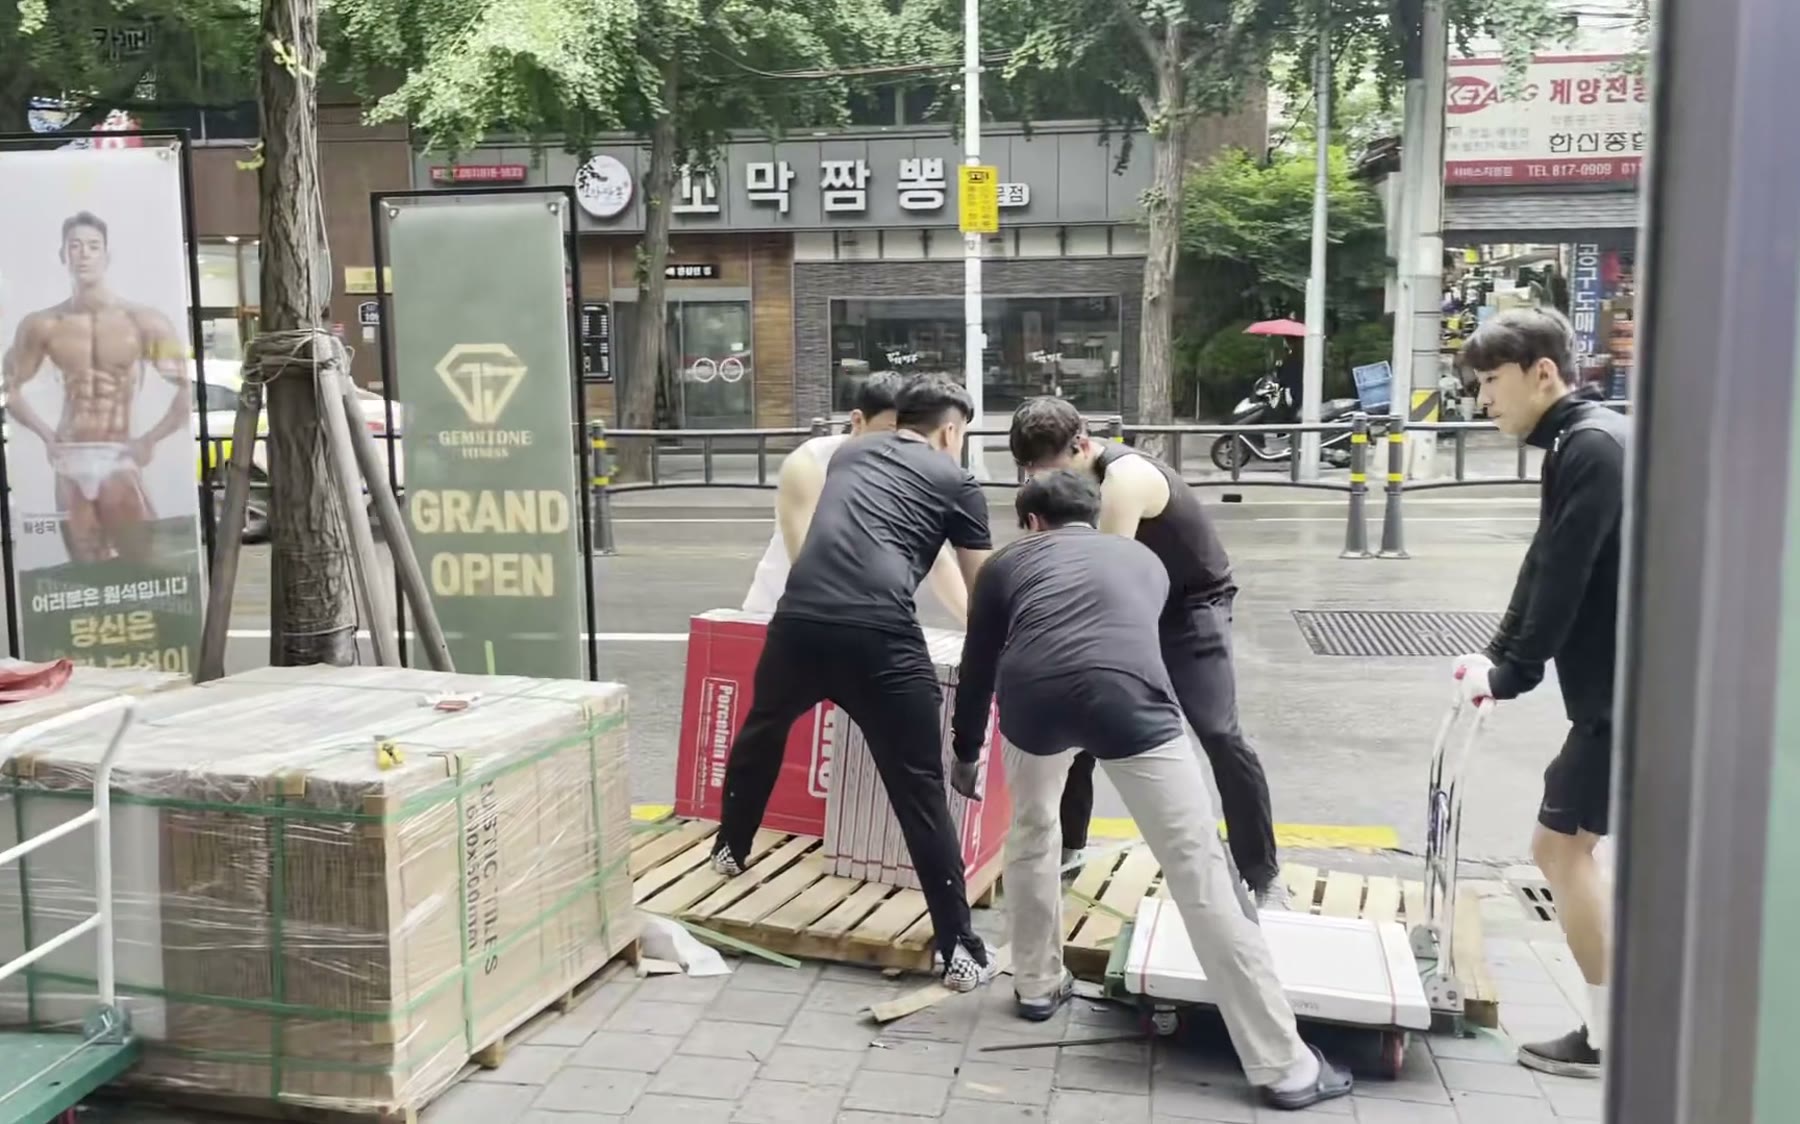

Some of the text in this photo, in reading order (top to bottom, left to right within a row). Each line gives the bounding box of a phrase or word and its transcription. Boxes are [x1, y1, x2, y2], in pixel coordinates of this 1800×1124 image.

[1448, 82, 1539, 106] KEYAG
[1527, 165, 1549, 178] TEL
[438, 430, 533, 447] GEMSTONE
[411, 489, 570, 535] GRAND
[431, 553, 554, 597] OPEN
[32, 576, 188, 612] 여러분은 원석입니다
[70, 610, 156, 648] 당신은
[713, 684, 734, 758] Porcelain
